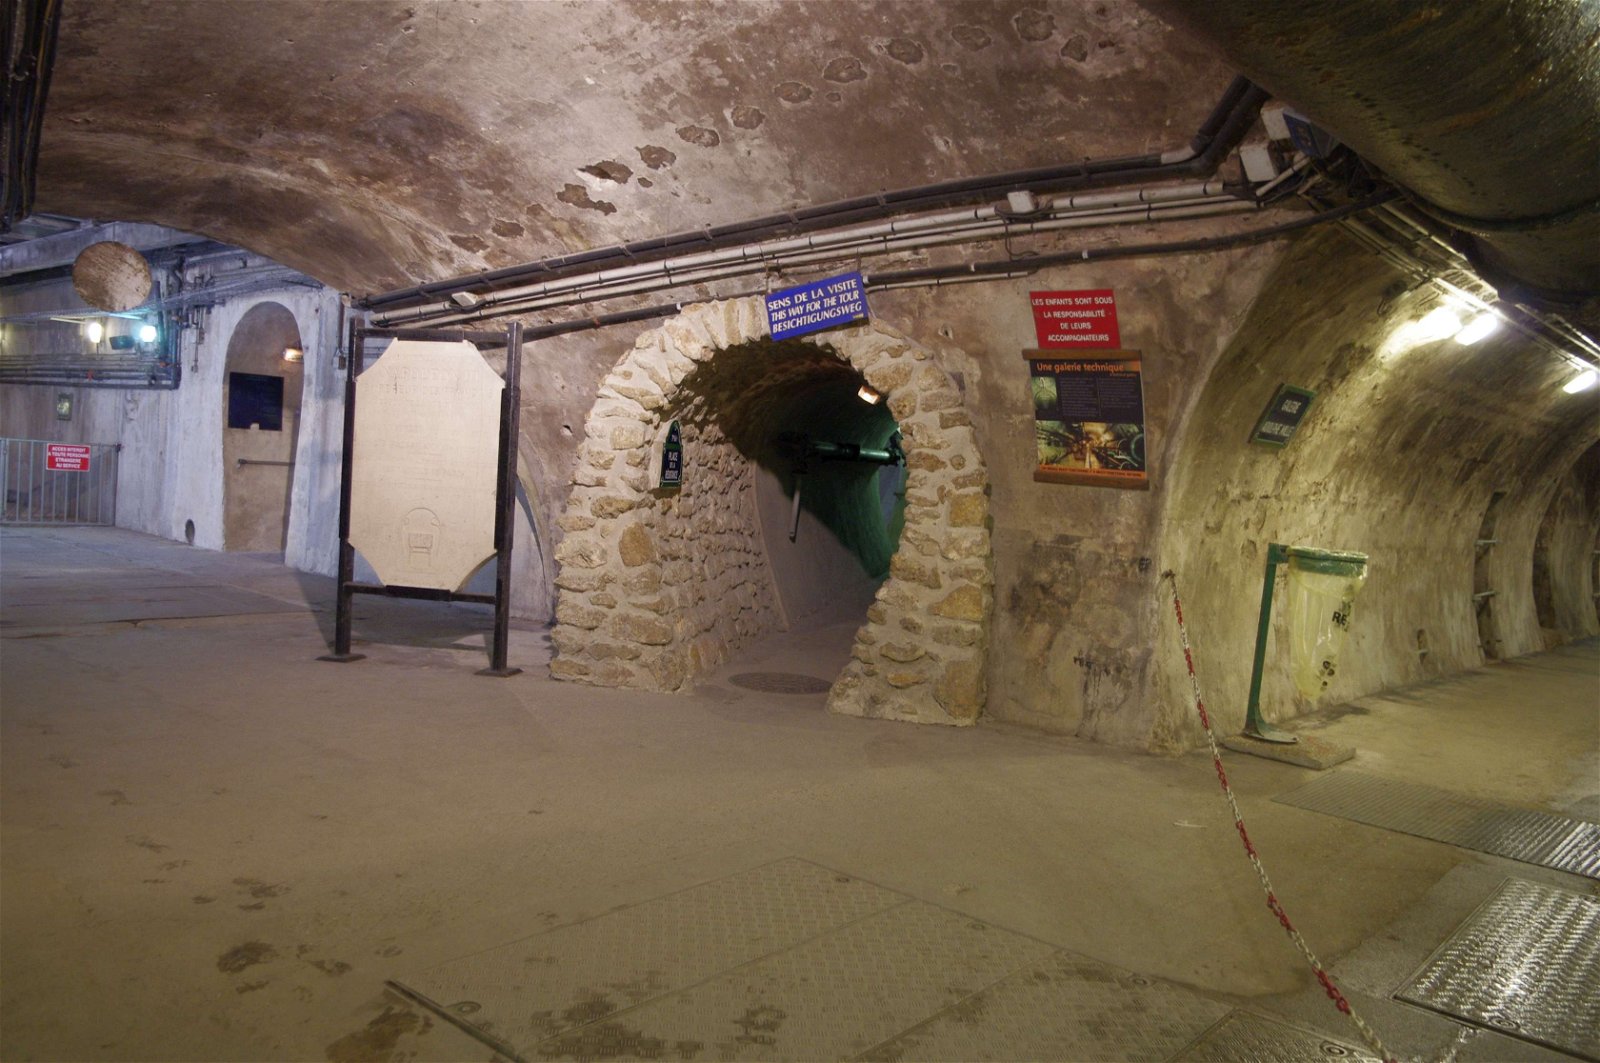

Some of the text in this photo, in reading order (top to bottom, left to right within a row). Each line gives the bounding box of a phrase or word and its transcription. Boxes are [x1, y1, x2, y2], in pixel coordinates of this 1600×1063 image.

[768, 279, 857, 311] SENS DE LA VISITE
[771, 290, 859, 322] THIS WAY FOR THE TOUR
[1032, 298, 1044, 306] LES
[1074, 297, 1092, 305] SONT
[1094, 296, 1113, 304] SOUS
[772, 301, 862, 333] BESICHTIGUNGSWEG
[1053, 308, 1105, 318] RESPONSABILITÉ
[1060, 322, 1092, 330] DE LEURS
[1048, 334, 1110, 342] ACCOMPAGNATEURS
[1036, 362, 1124, 374] Une galerie technique
